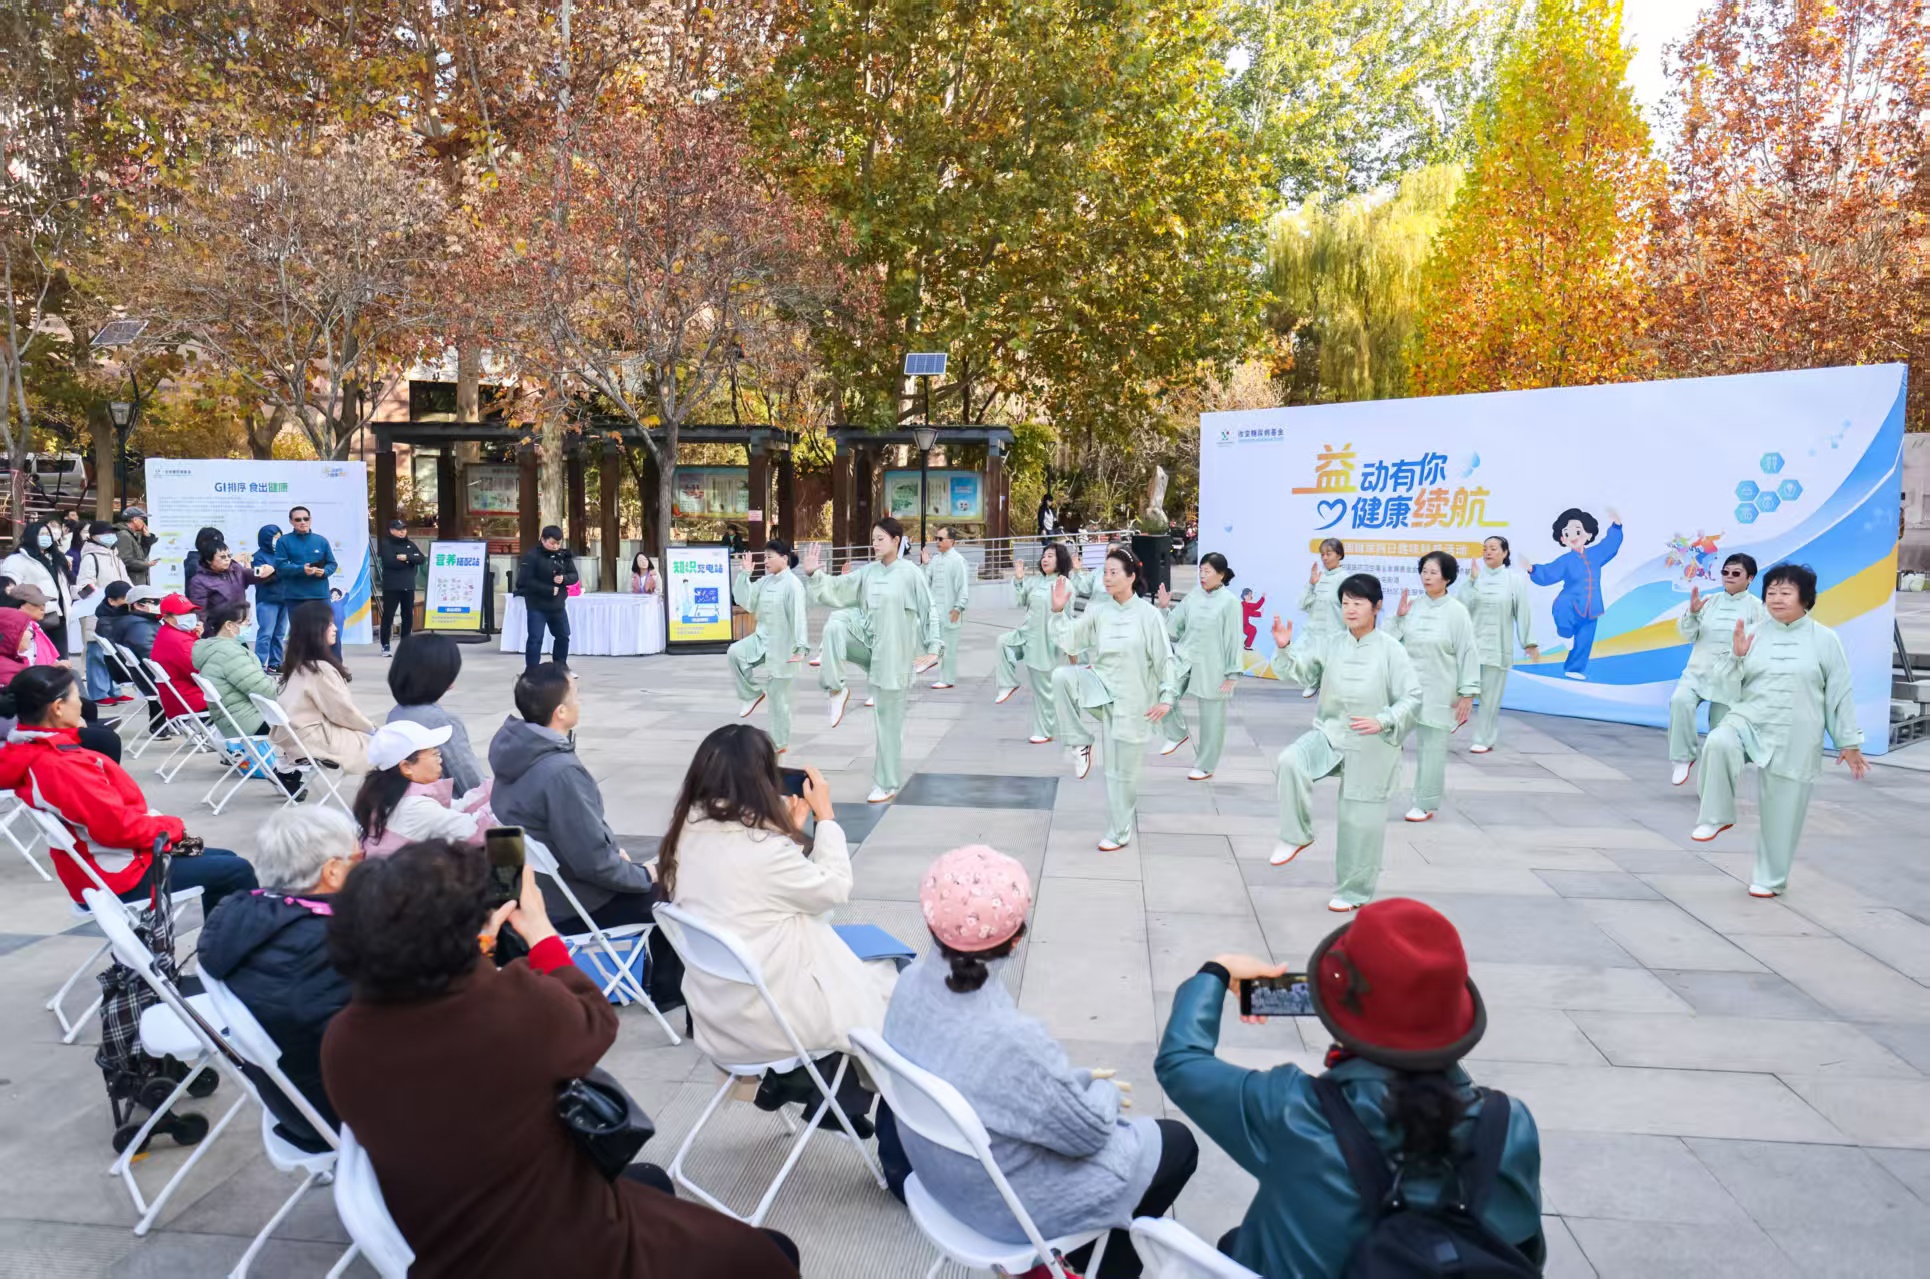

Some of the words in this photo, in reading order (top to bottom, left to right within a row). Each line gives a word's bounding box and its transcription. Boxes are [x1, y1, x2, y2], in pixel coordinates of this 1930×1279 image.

[1292, 442, 1448, 494] 益动有你
[1351, 486, 1509, 529] 健康续航
